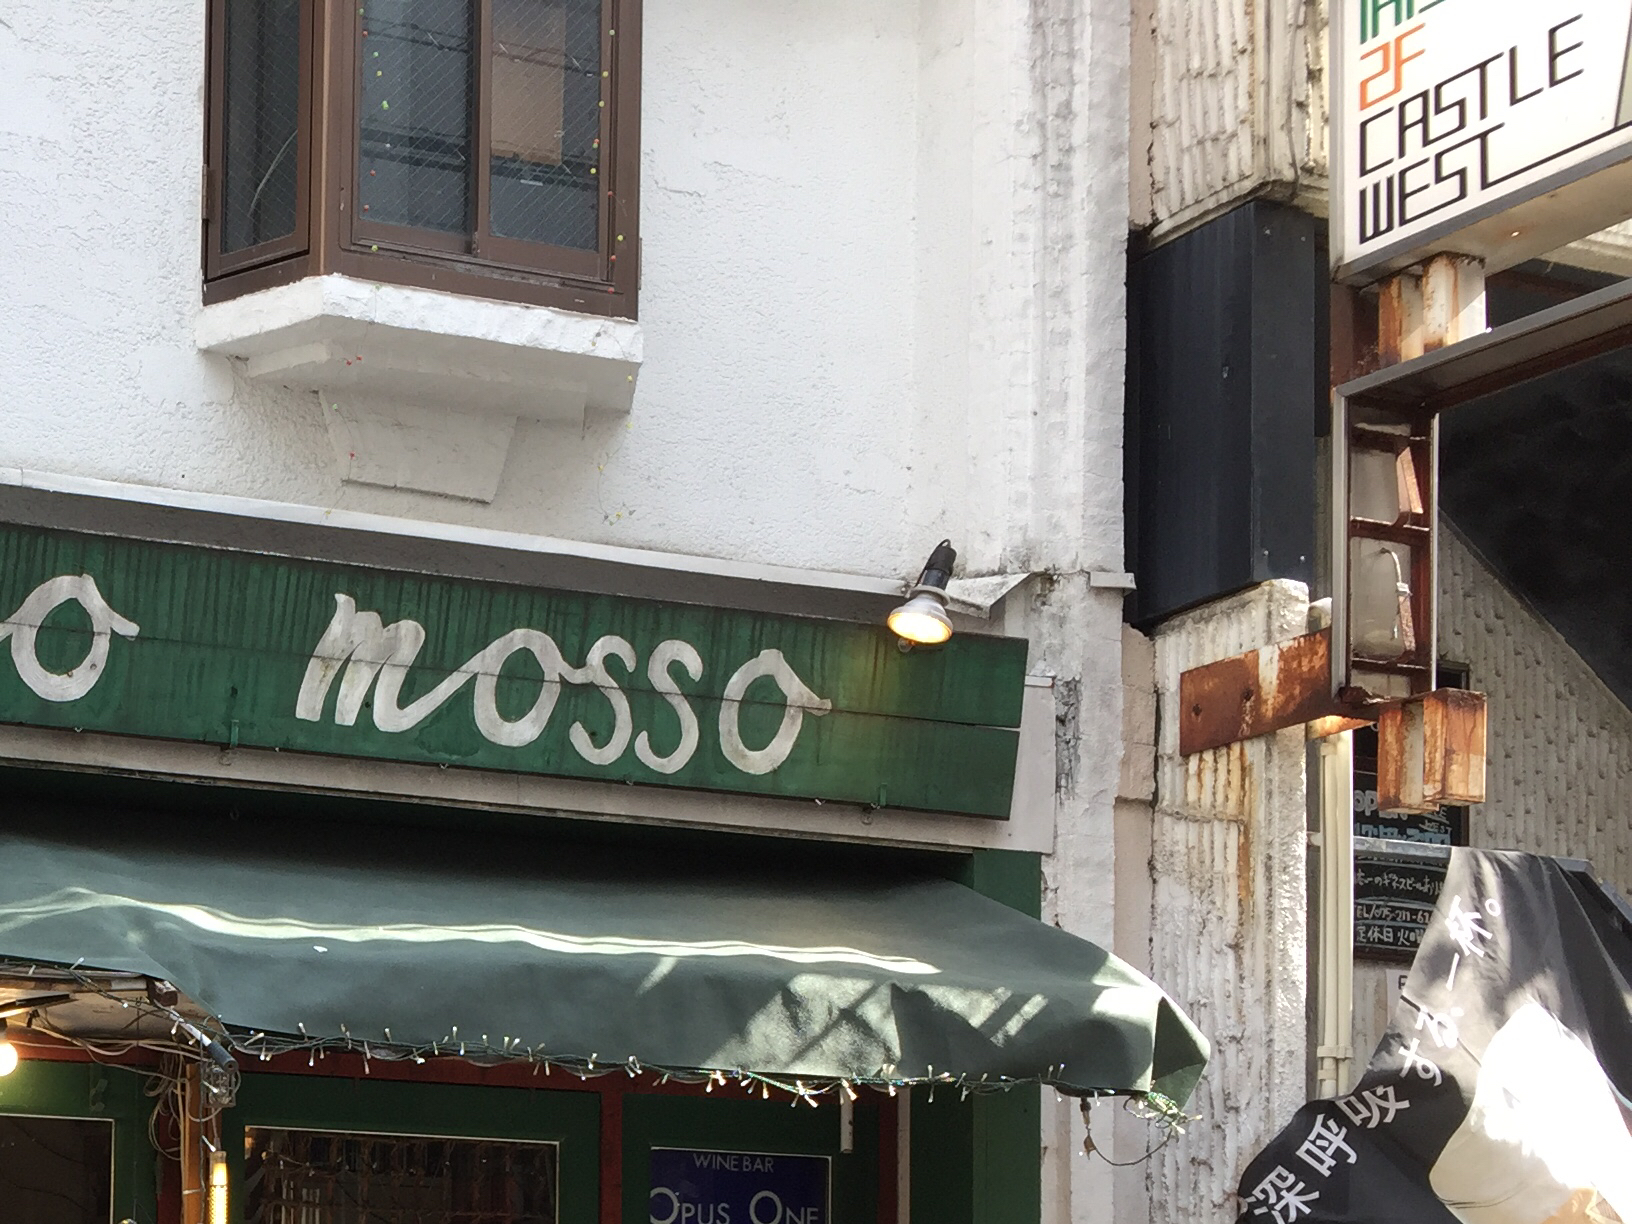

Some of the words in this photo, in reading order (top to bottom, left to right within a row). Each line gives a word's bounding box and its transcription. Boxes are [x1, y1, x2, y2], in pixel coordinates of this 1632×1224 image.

[1360, 23, 1425, 111] 2F
[1360, 14, 1584, 177] CASTLE
[1360, 121, 1506, 244] WEST
[693, 1153, 739, 1172] WINE
[742, 1155, 774, 1173] BAR
